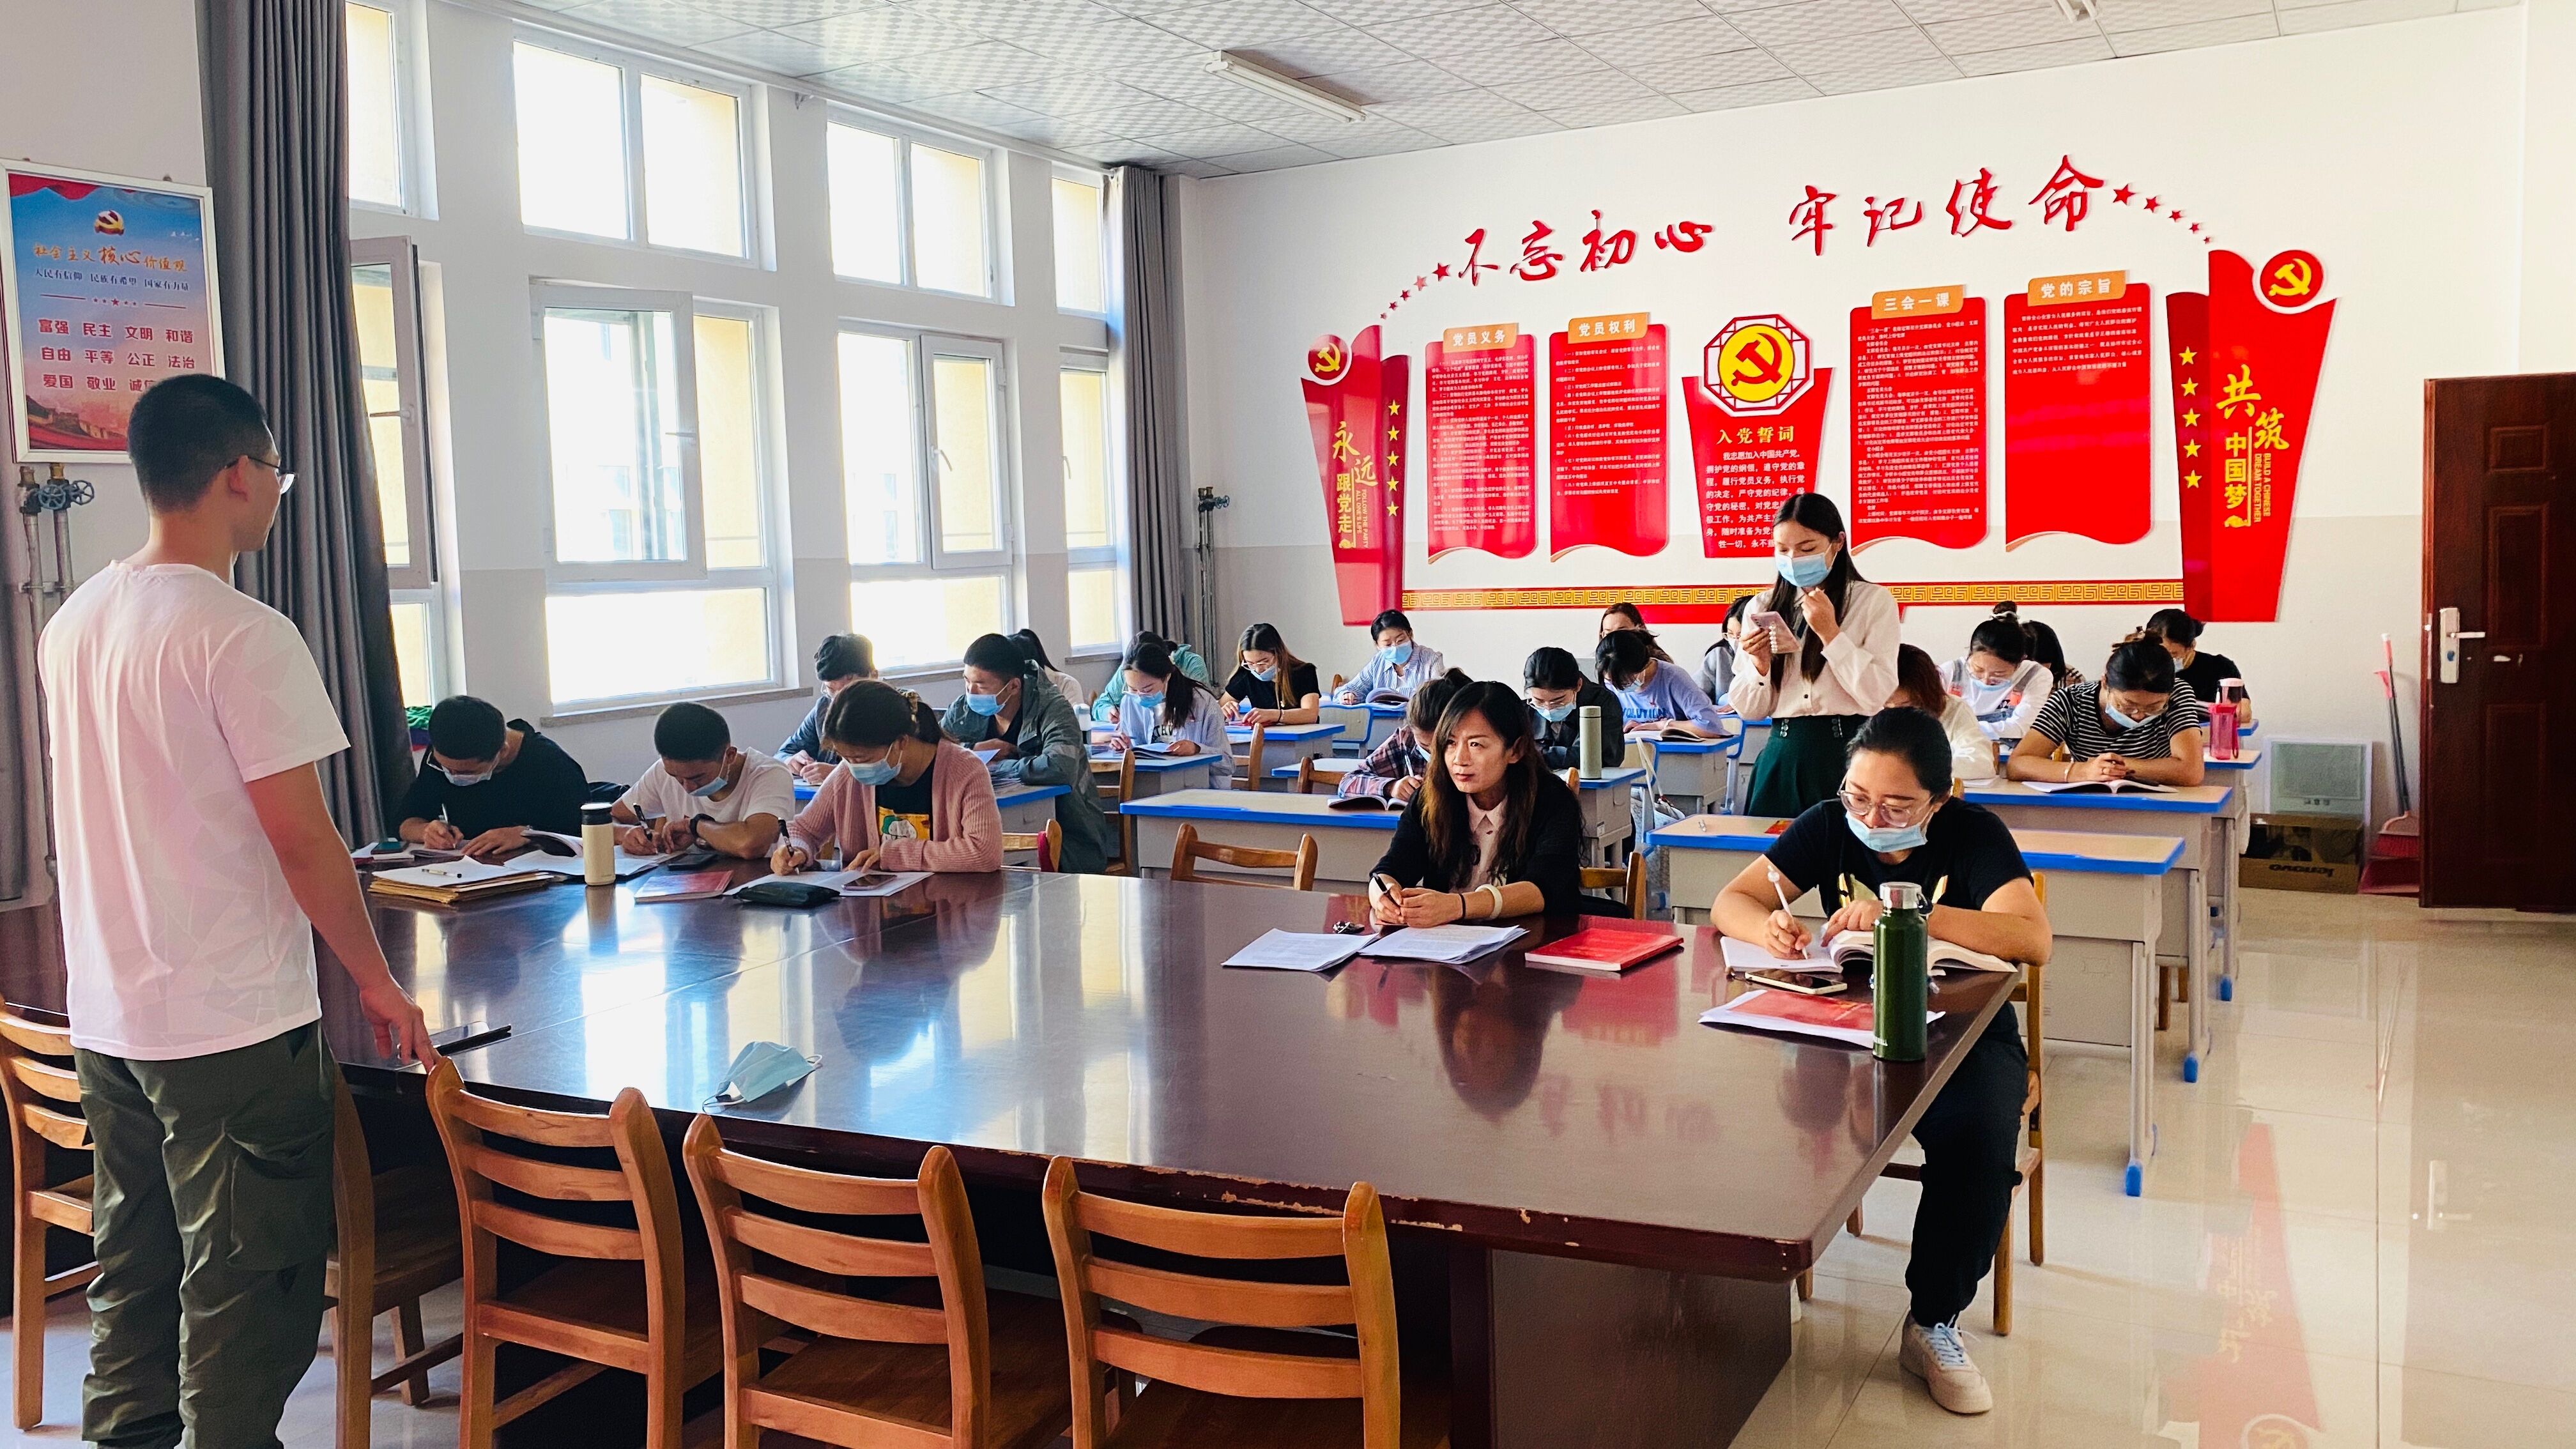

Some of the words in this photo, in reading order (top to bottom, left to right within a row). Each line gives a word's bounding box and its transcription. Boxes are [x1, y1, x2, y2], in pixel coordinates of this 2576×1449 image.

[1459, 209, 1713, 285] 不忘初心
[1788, 155, 2105, 257] 牢记使命
[34, 245, 187, 272] 社会主义核心价值观
[36, 268, 82, 280] 人民有信仰
[90, 273, 137, 285] 民族有希望
[2041, 278, 2111, 298] 党的宗旨
[1883, 292, 1950, 311] 三会一课
[39, 319, 69, 335] 富强
[83, 323, 112, 337] 民主
[125, 326, 153, 341] 文明
[165, 329, 193, 343] 和谐
[1452, 329, 1505, 347] 党员义务
[1579, 319, 1636, 337] 党员权利
[42, 347, 71, 361] 自由
[85, 349, 114, 364] 平等
[128, 352, 155, 367] 公正
[168, 355, 194, 369] 法治
[43, 374, 73, 388] 爱国
[87, 376, 116, 390] 敬业
[2216, 364, 2290, 450] 共筑
[1716, 425, 1794, 445] 入党誓词
[1333, 421, 1378, 486] 永远
[2224, 433, 2247, 509] 中国梦
[1337, 473, 1353, 533] 跟党走
[1706, 525, 1773, 537] 身，随时准备为党
